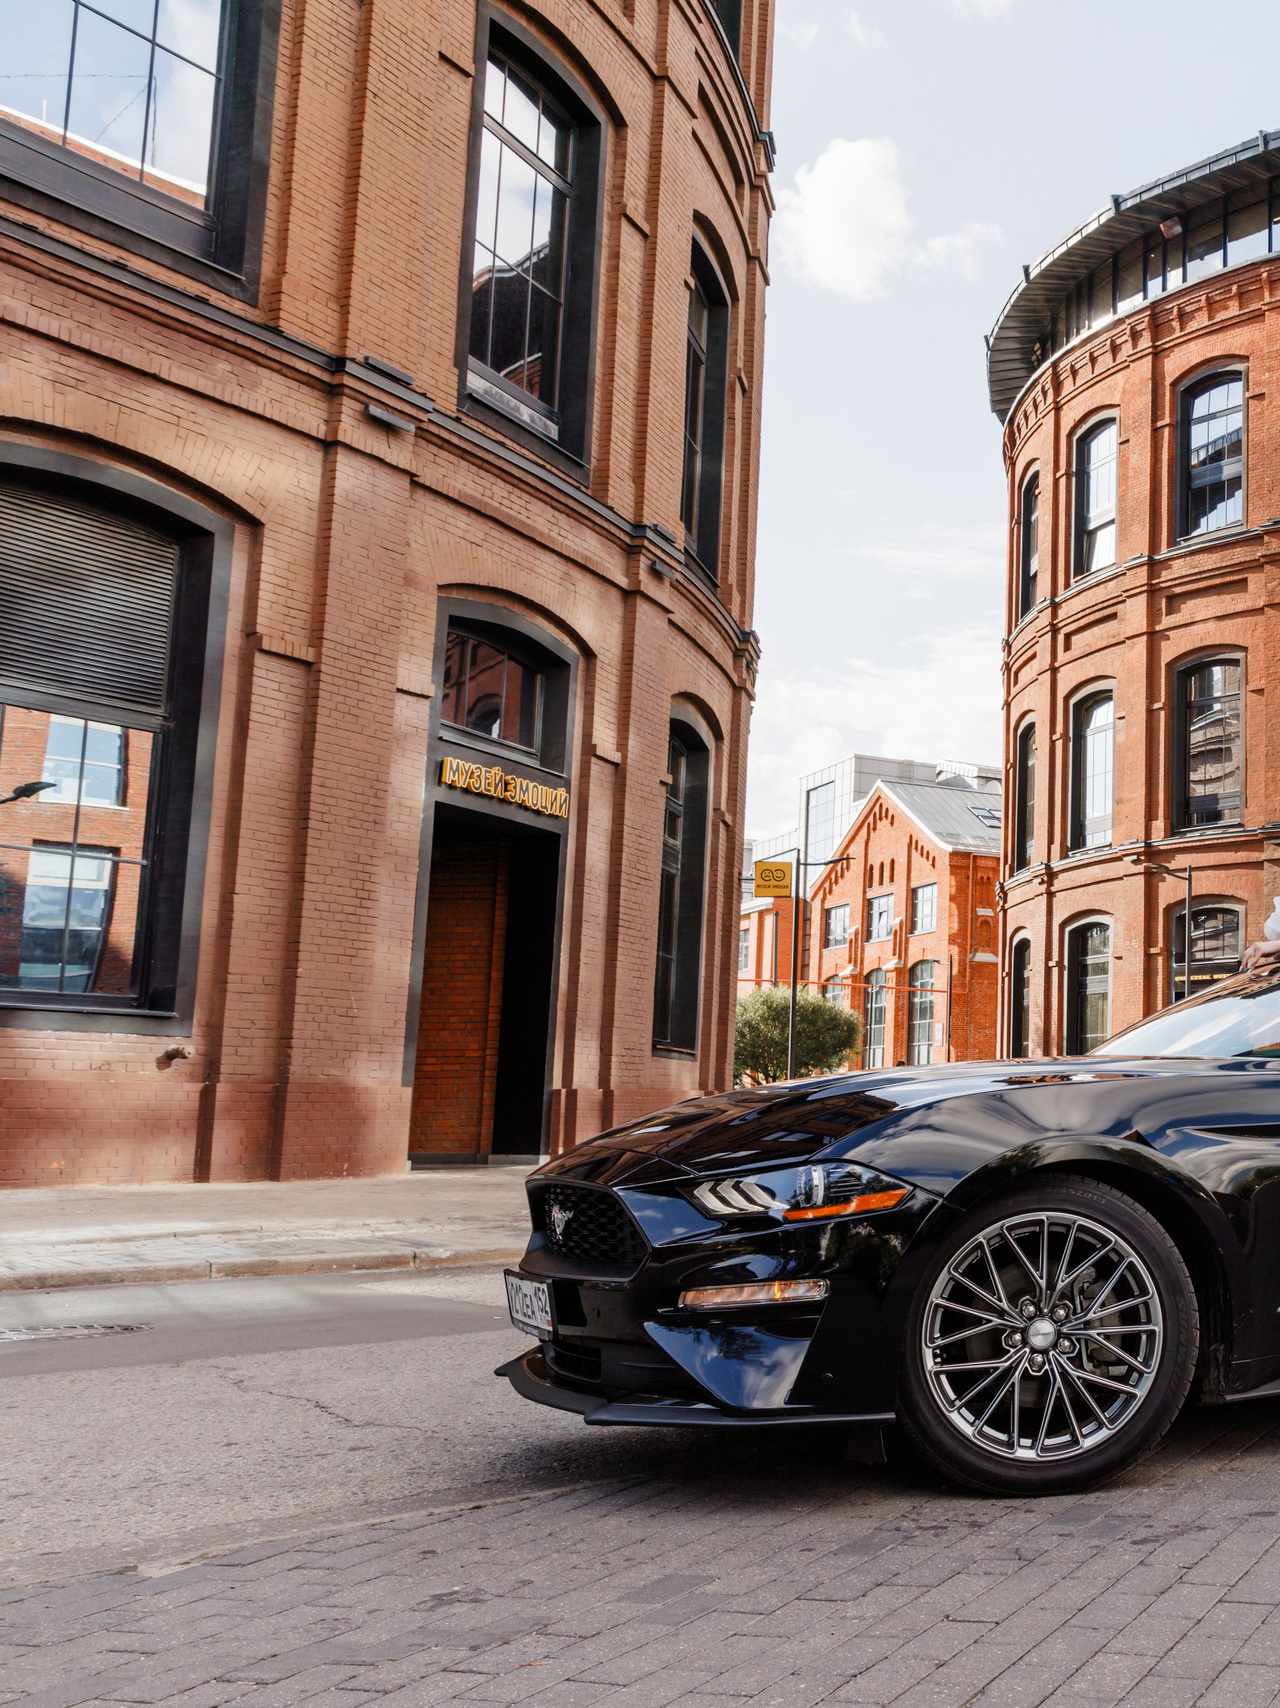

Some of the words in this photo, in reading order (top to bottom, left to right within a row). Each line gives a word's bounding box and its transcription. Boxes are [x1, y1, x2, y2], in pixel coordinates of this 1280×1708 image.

[442, 757, 505, 799] МУЗЕЙ
[505, 775, 570, 818] ЭМОЦИЙ
[533, 1285, 549, 1315] 152
